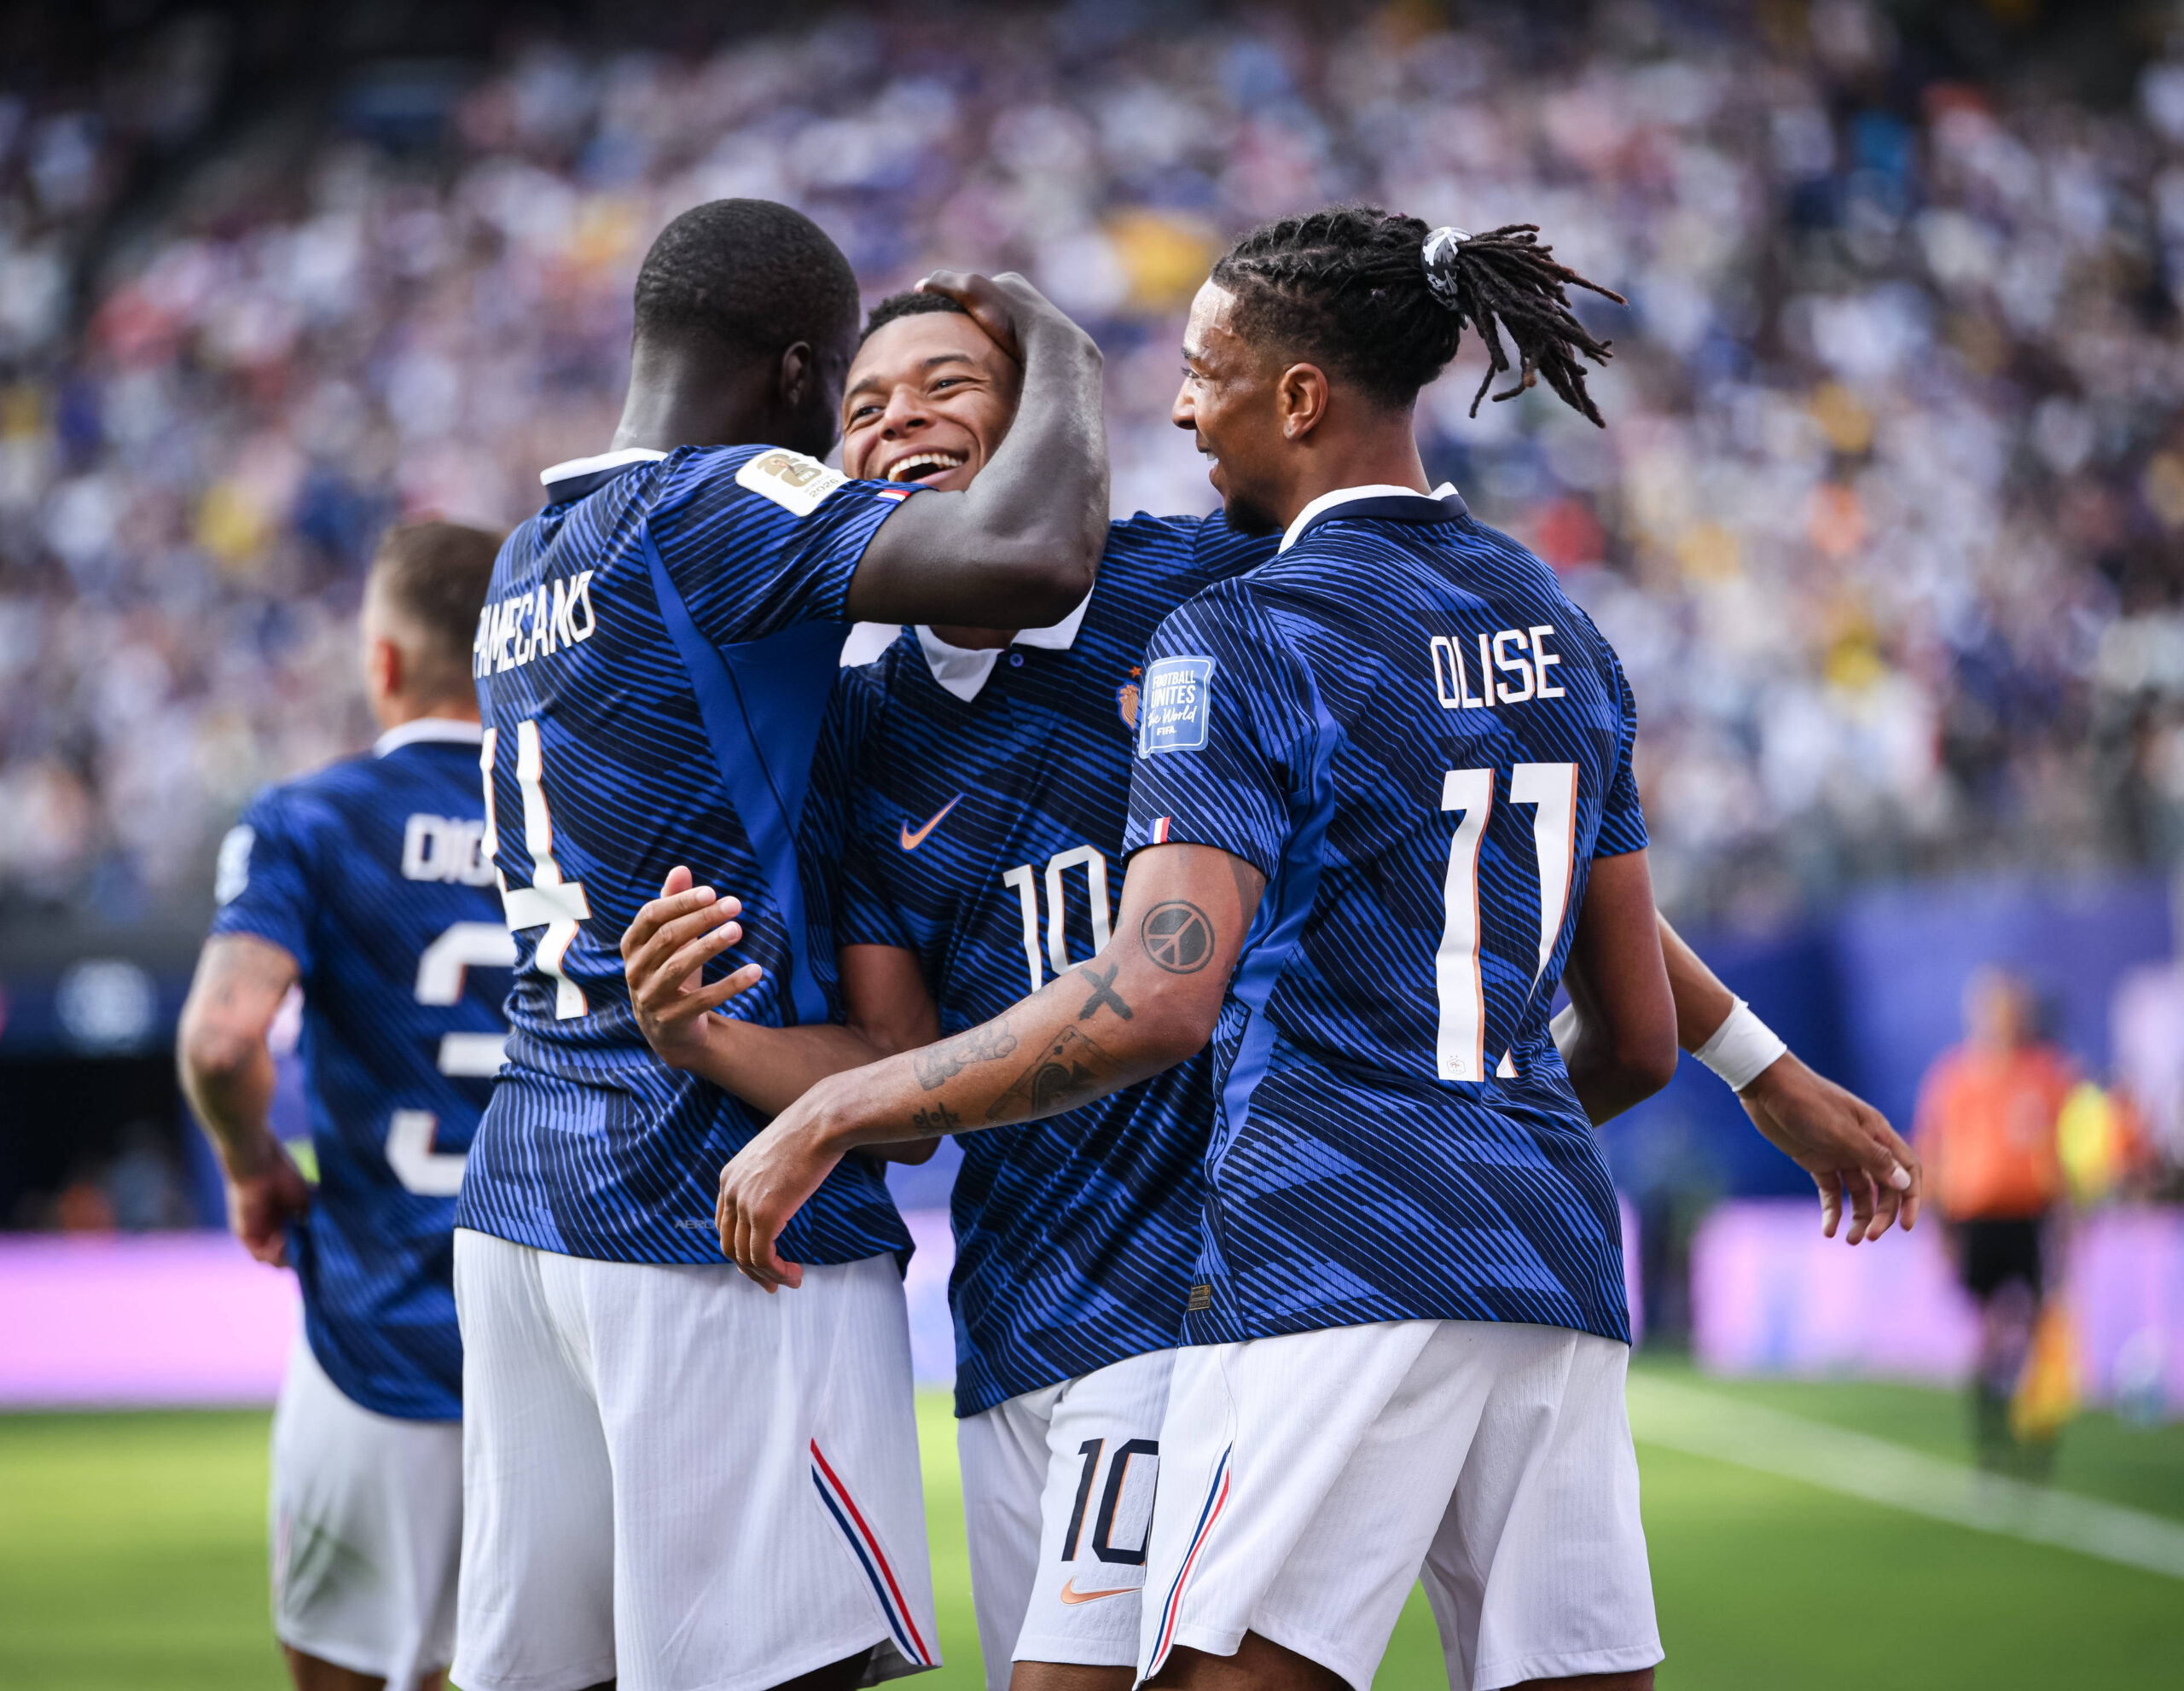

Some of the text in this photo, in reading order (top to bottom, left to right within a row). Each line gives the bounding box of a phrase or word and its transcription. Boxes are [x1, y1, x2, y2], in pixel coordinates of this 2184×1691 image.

[810, 478, 839, 497] 2026
[1151, 684, 1196, 709] UNITES
[1153, 670, 1196, 690] FOOTBALL
[1430, 625, 1565, 709] OLISE
[1147, 705, 1198, 729] the World
[1156, 725, 1176, 735] FIFA
[401, 813, 497, 886] DIG
[479, 719, 593, 1020] 4
[1002, 845, 1113, 994] 10
[1436, 763, 1578, 1083] 11
[386, 921, 517, 1196] 3
[1060, 1438, 1159, 1566] 10
